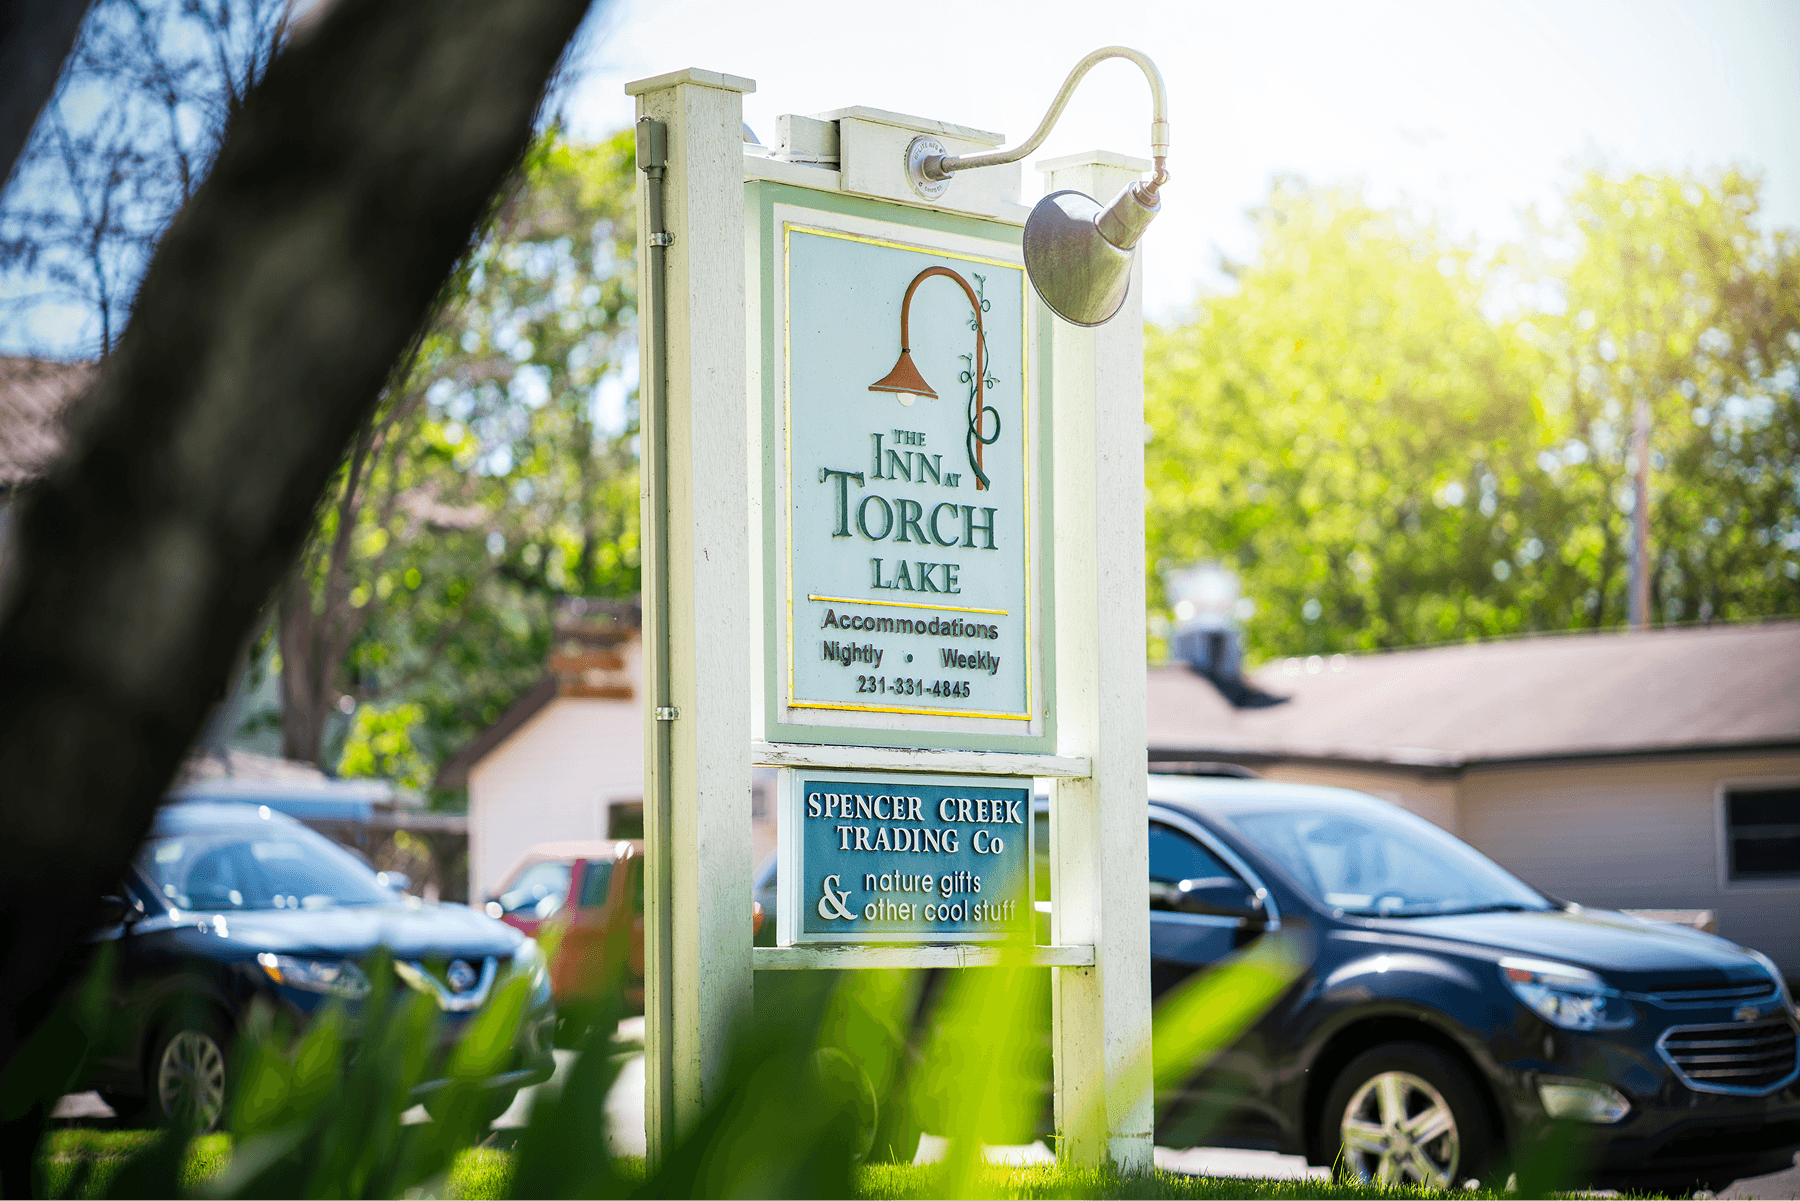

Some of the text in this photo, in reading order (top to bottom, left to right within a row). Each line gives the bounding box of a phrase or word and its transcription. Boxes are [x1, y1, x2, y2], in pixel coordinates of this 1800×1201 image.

[893, 429, 926, 446] THE
[871, 433, 961, 487] INN AT
[820, 467, 999, 550] TORCH
[870, 557, 961, 594] LAKE
[821, 608, 999, 640] Accommodations
[822, 640, 1000, 675] Nightly Weekly
[856, 675, 971, 698] 231-331-4845
[808, 792, 1023, 824] SPENCER CREEK
[836, 825, 1004, 854] TRADING Co
[818, 874, 858, 920] &
[865, 870, 981, 898] nature gifts
[864, 899, 1015, 921] other cool stuff
